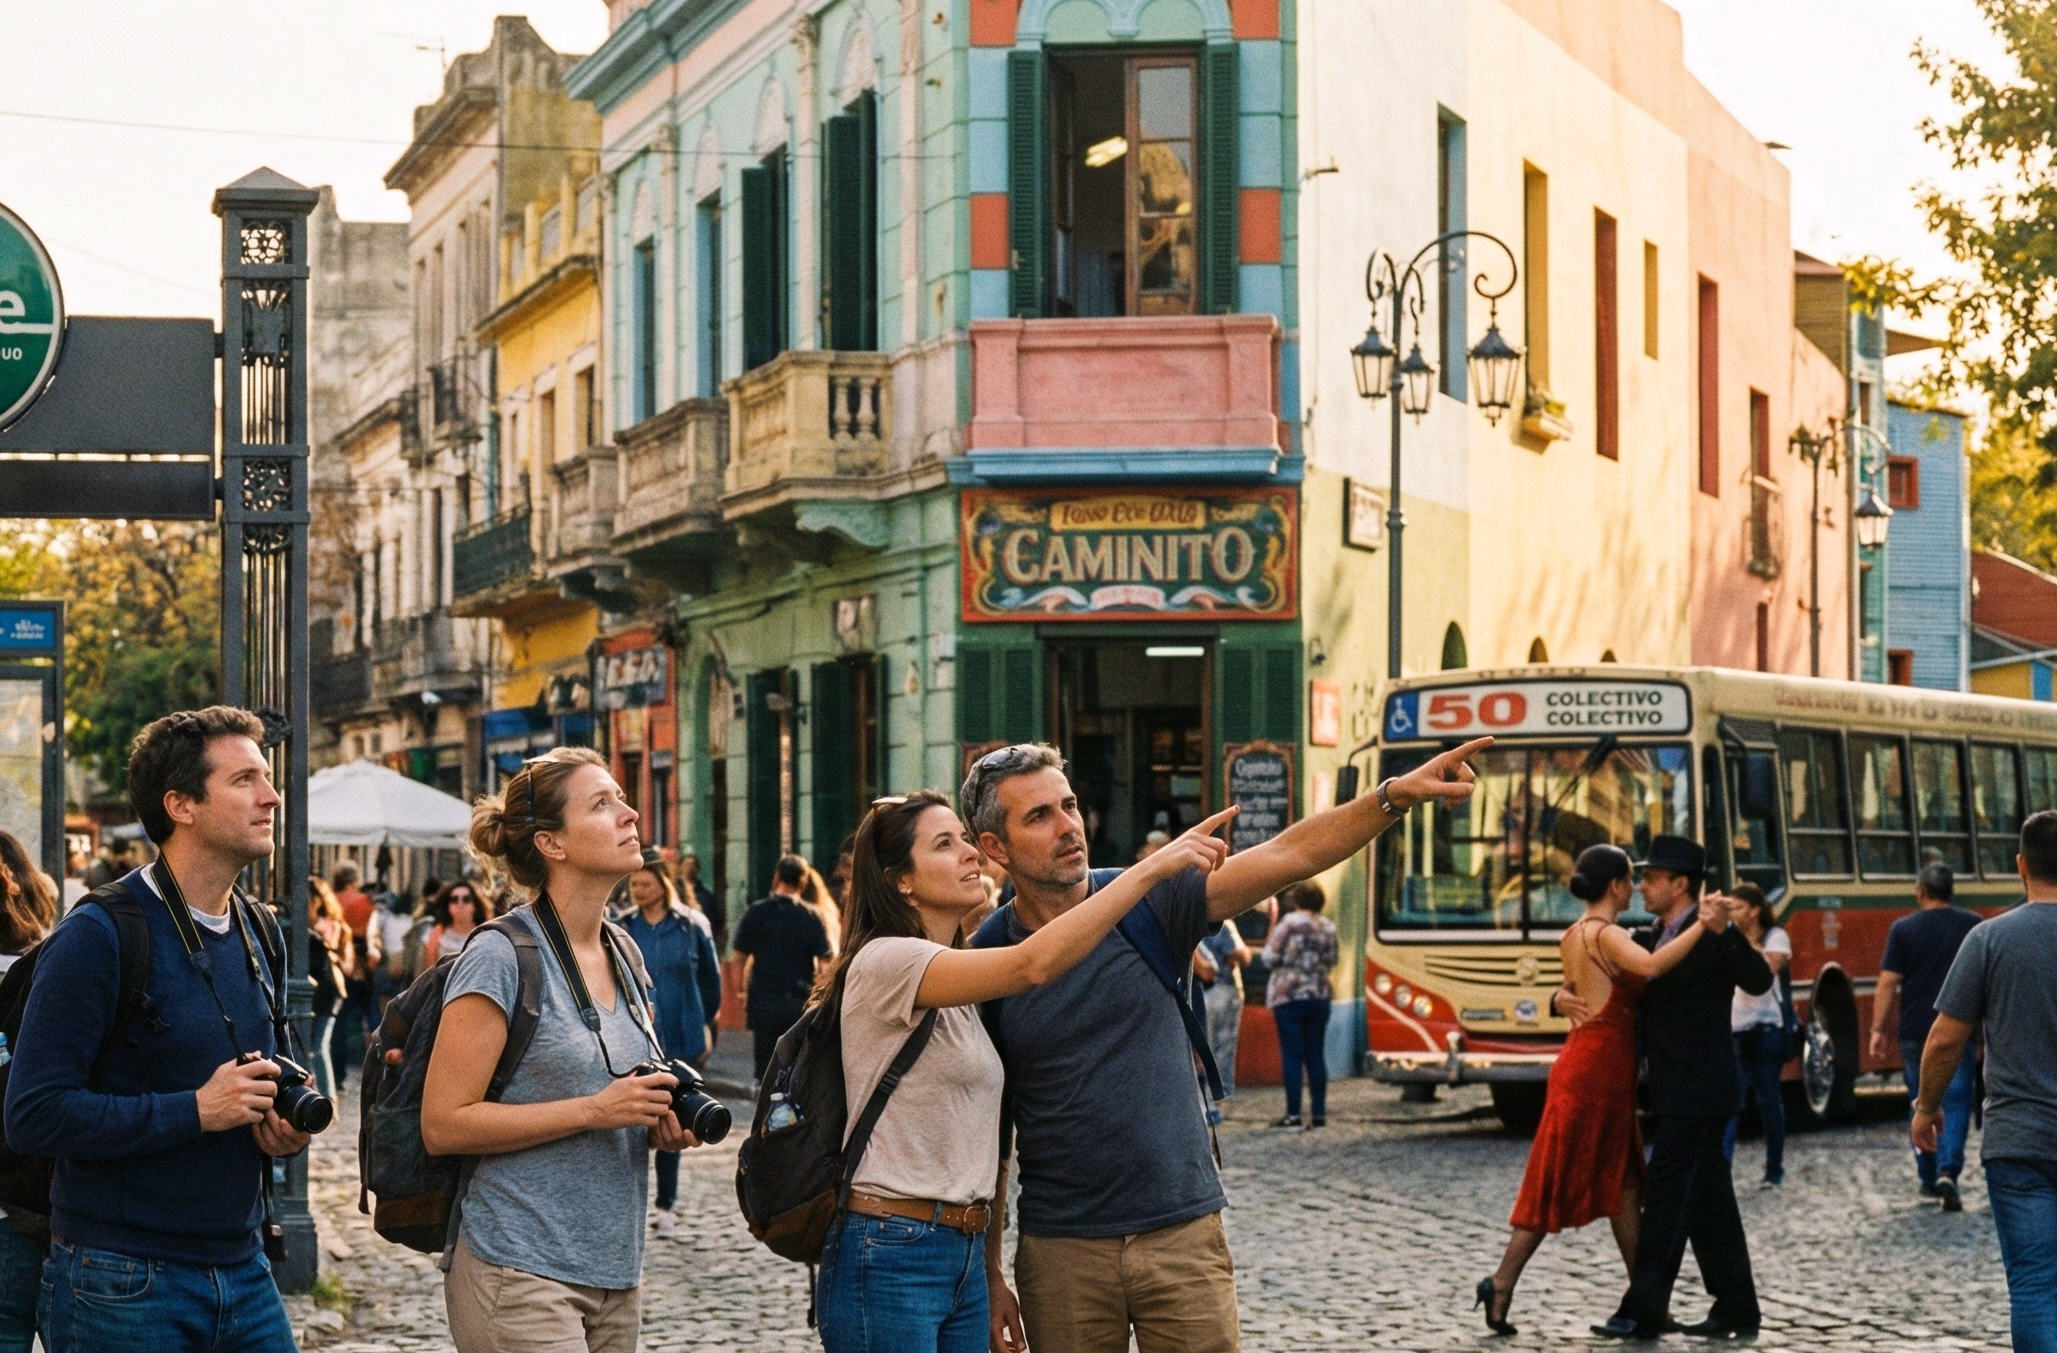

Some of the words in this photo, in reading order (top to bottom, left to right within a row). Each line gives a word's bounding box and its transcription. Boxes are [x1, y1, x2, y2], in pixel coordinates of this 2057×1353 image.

[0, 347, 23, 360] UO
[1002, 527, 1256, 585] CAMINITO
[1547, 691, 1662, 707] COLECTIVO
[1428, 691, 1527, 730] 50
[1547, 710, 1662, 726] COLECTIVO
